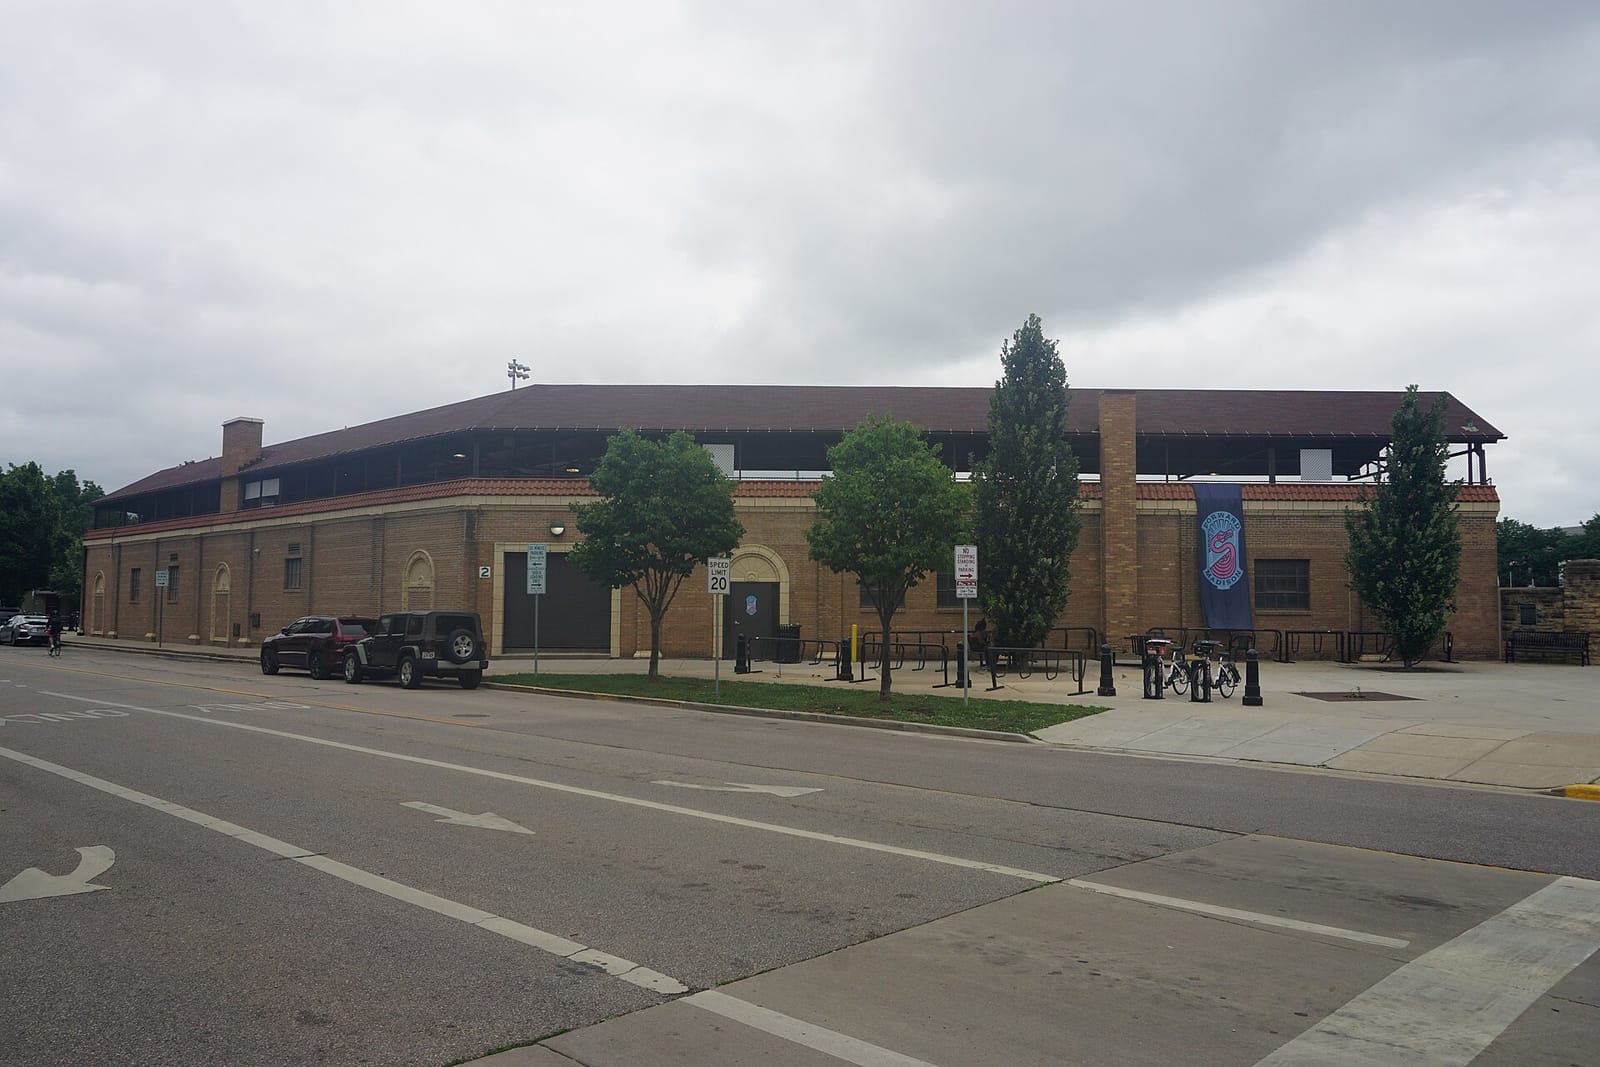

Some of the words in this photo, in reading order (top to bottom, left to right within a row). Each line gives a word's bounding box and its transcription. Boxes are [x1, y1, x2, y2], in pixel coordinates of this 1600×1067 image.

[1203, 512, 1241, 530] FORWARD
[709, 561, 729, 569] SPEED
[481, 567, 489, 577] 2
[1204, 569, 1242, 586] MADISON
[711, 577, 727, 590] 20
